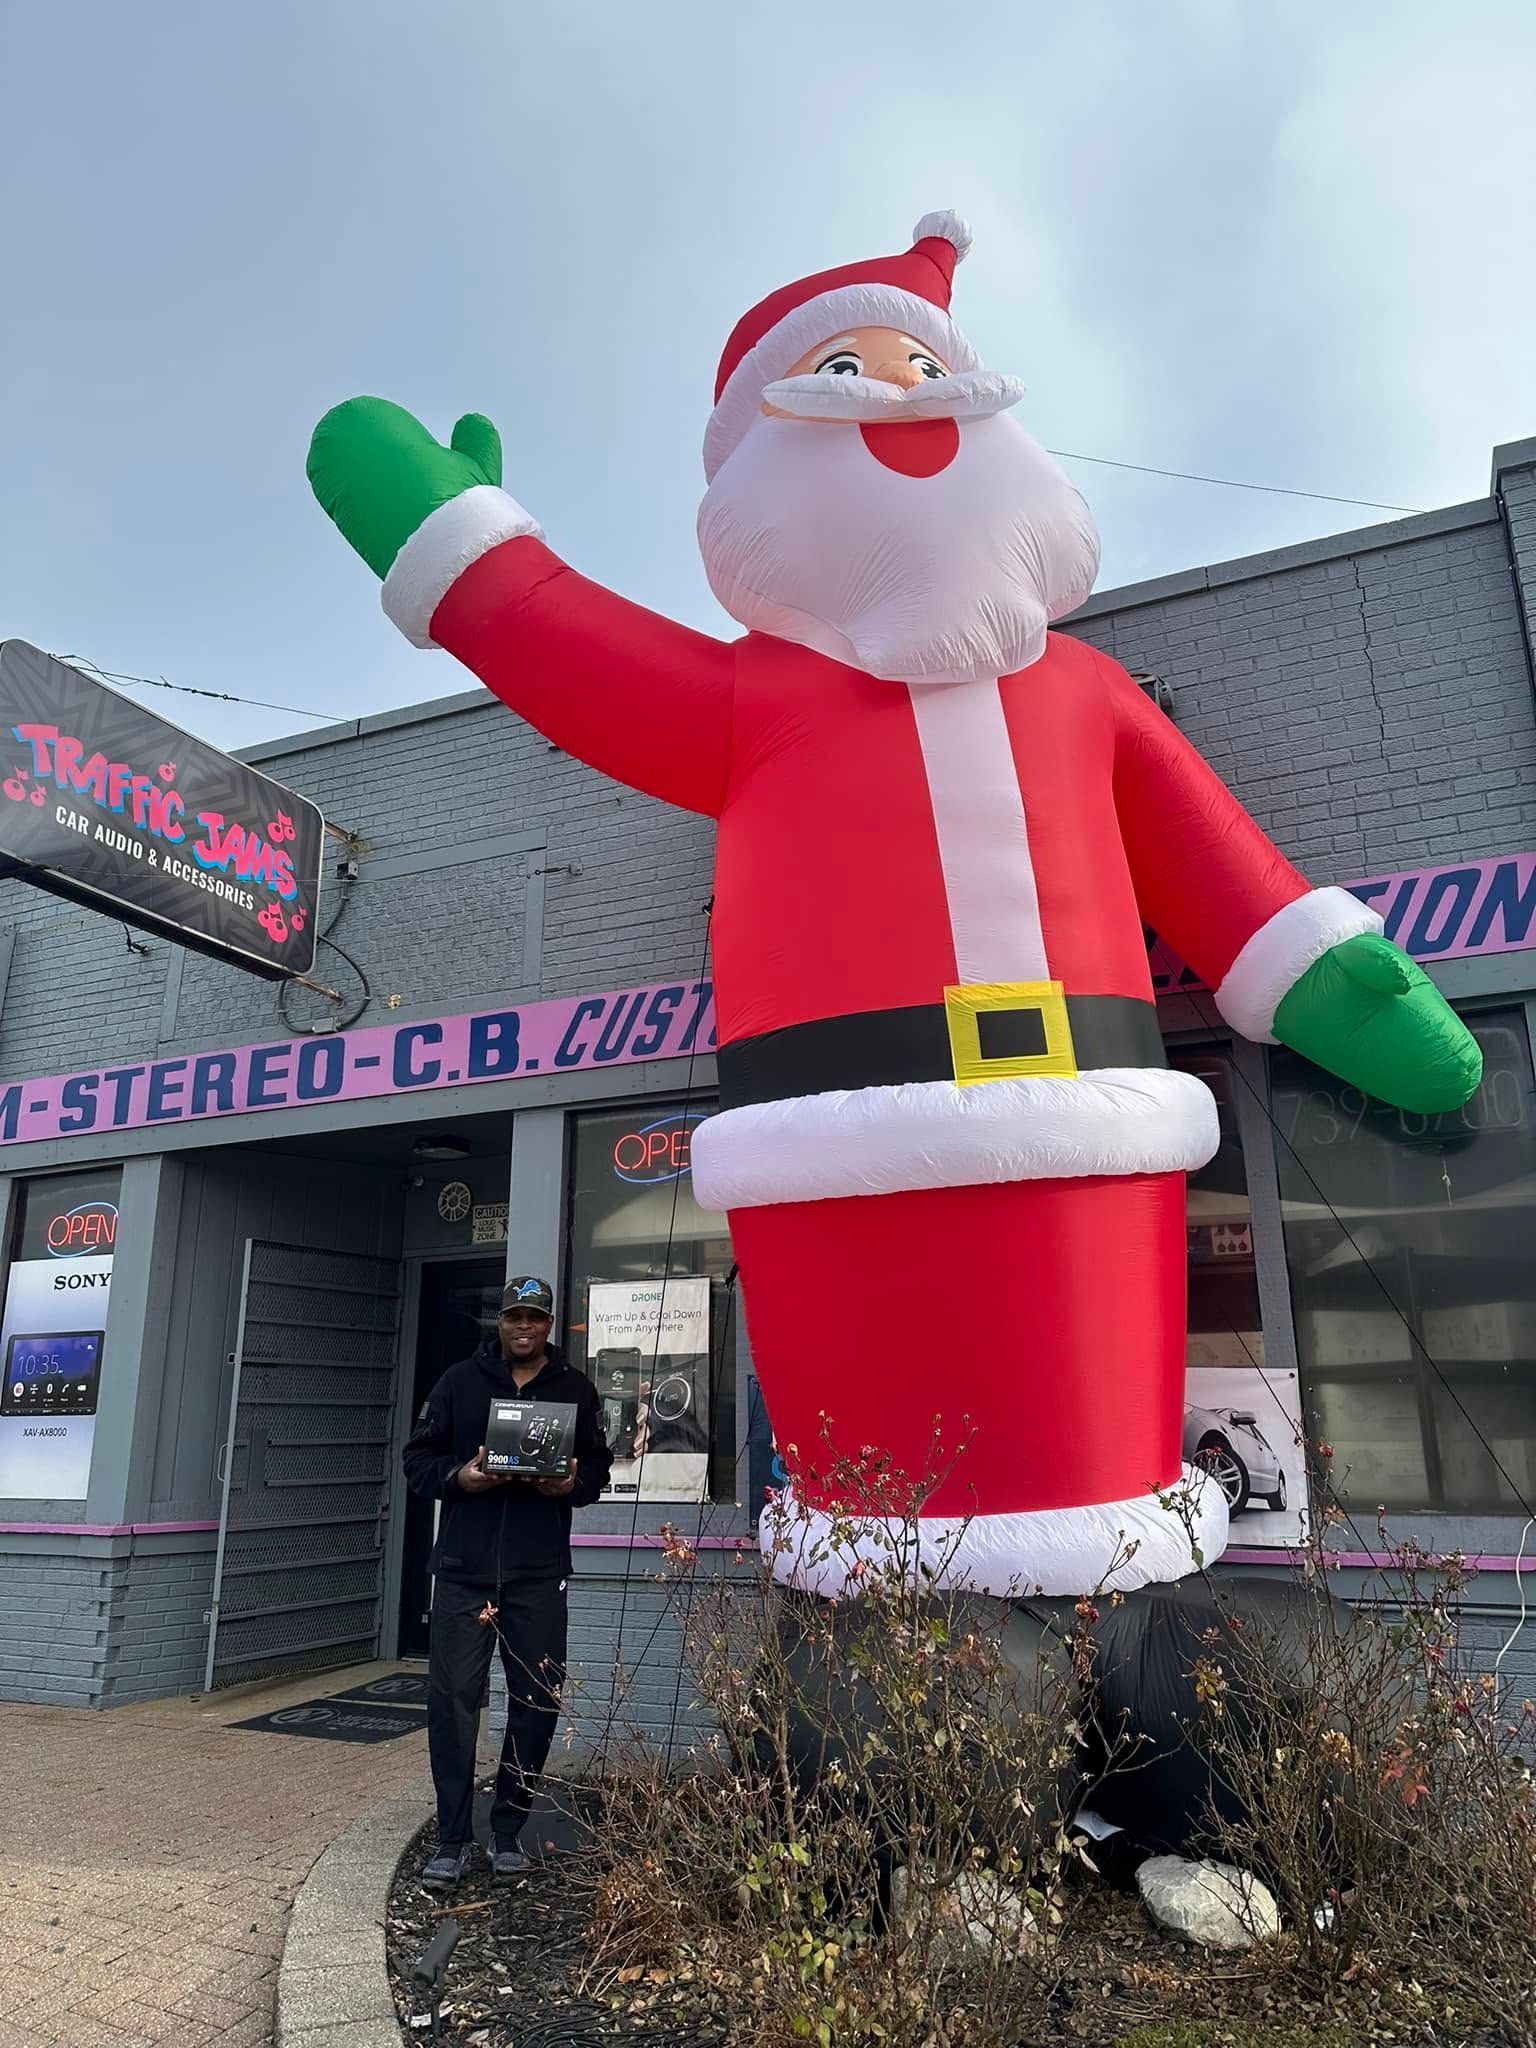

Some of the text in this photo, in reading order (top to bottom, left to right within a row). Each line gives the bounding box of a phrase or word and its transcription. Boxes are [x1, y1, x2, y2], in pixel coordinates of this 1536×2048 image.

[12, 724, 298, 901] TRAFFIC JAMS
[56, 805, 255, 911] CAR AUDIO & ACCESSORIES
[554, 983, 717, 1067] CUST
[476, 1206, 509, 1218] CAUTIO
[48, 1214, 118, 1246] OPEN
[476, 1232, 496, 1241] ZONE
[54, 1273, 112, 1291] SONY
[632, 1293, 663, 1302] DRONE
[595, 1309, 702, 1322] Warm Up & Cool Down
[608, 1325, 632, 1334] From
[19, 1354, 60, 1375] 10:35
[23, 1427, 68, 1437] XAV-AX8000
[487, 1454, 520, 1465] 9900AS
